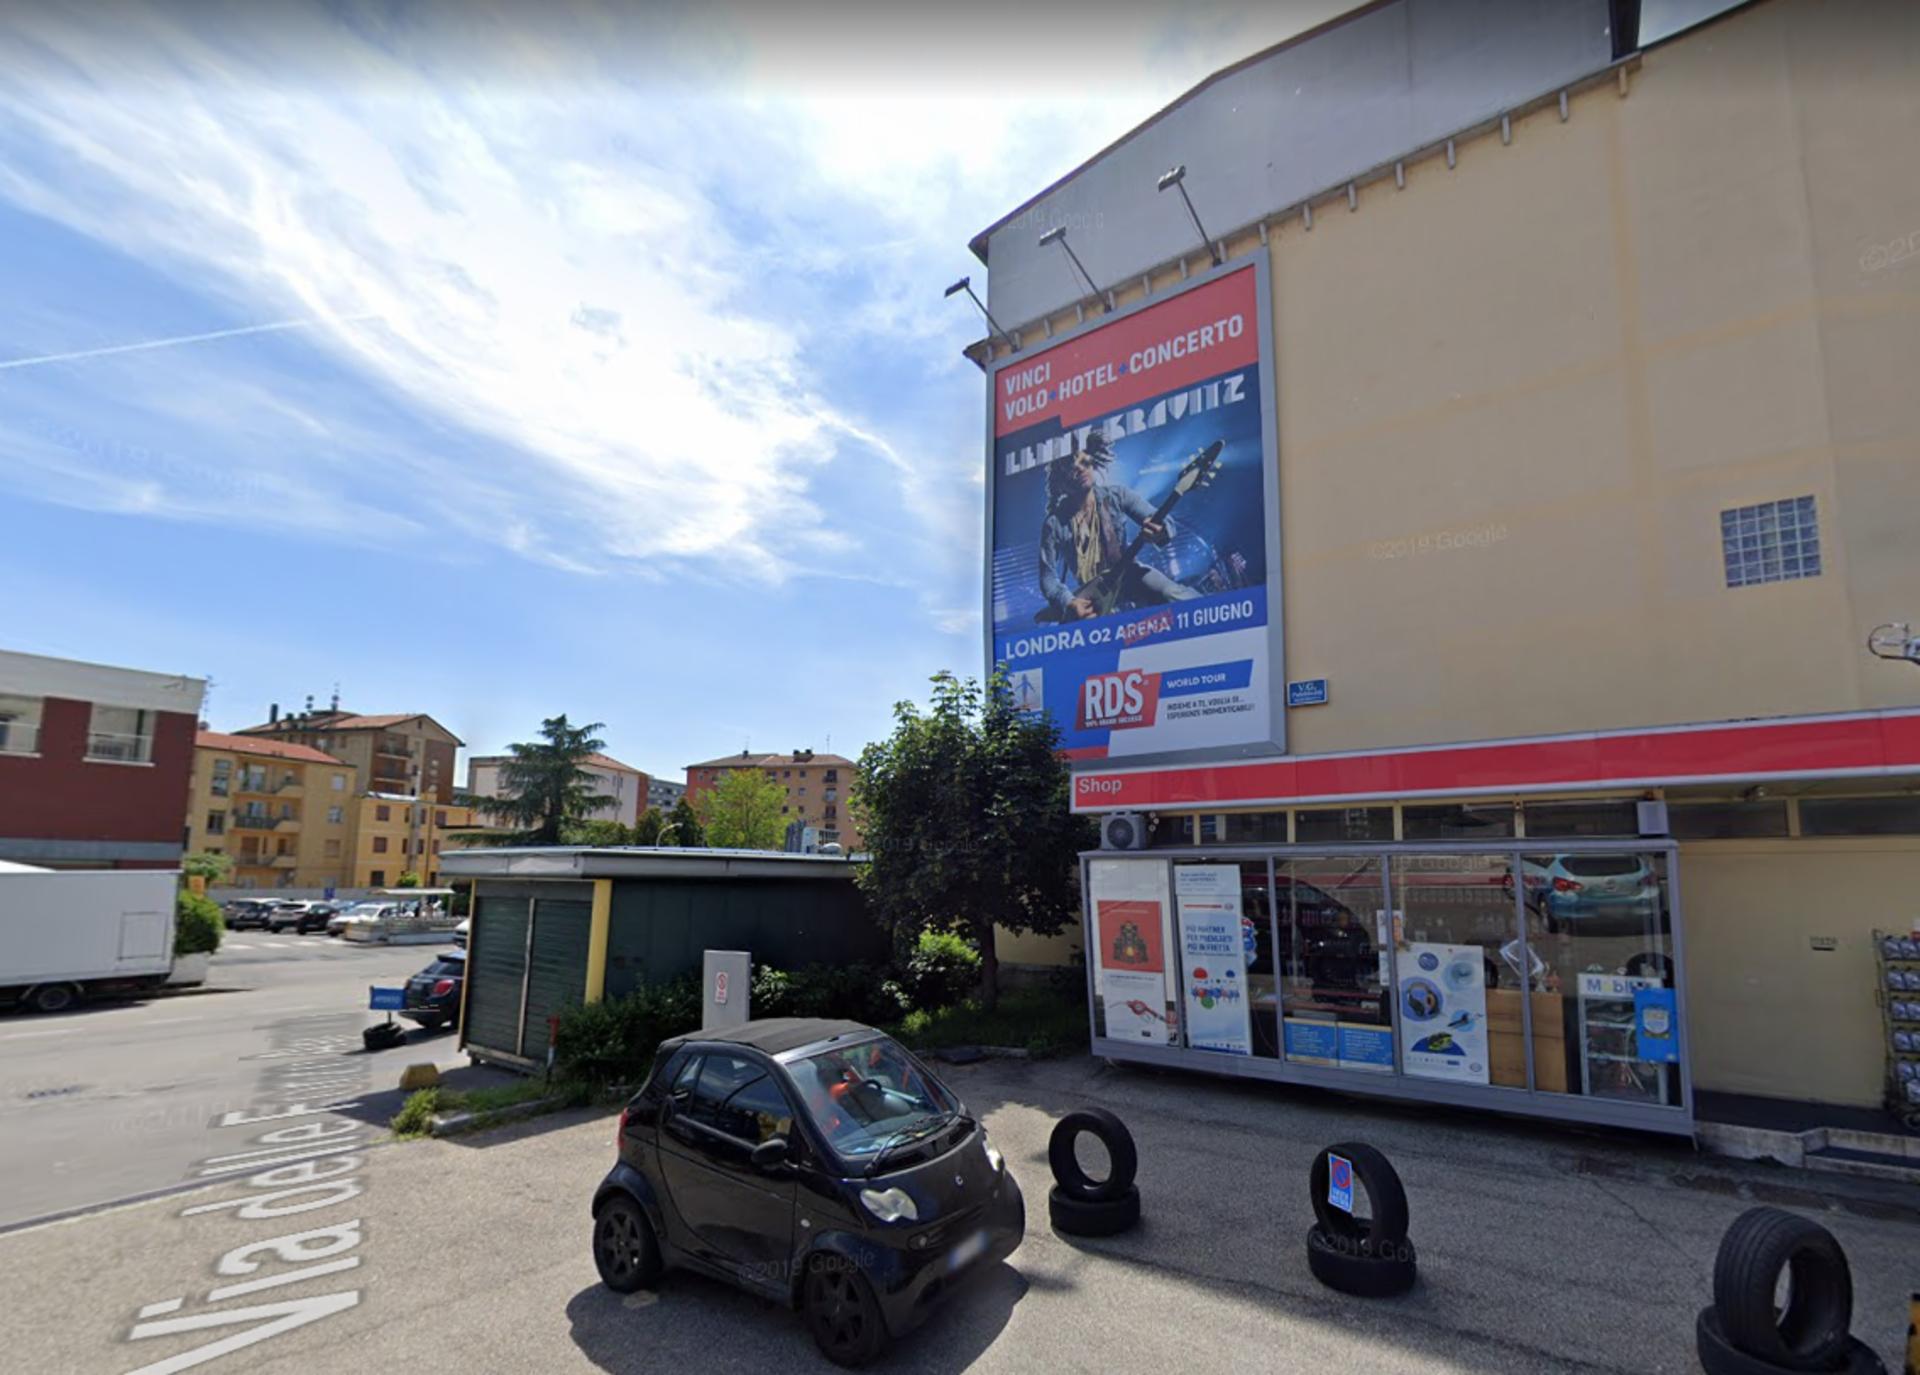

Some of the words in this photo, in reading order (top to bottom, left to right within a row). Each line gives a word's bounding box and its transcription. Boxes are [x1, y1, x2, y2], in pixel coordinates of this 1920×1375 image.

[1005, 388, 1047, 421] VOLO
[1059, 364, 1118, 401] HOTEL
[1129, 314, 1244, 375] CONCERTO
[1005, 362, 1050, 396] VINCI
[1006, 629, 1085, 661] LONDRA
[1116, 617, 1172, 640] ARENA
[1177, 612, 1190, 629] 11
[1194, 601, 1254, 627] GIUGNO
[1085, 673, 1143, 720] RDS
[1167, 676, 1200, 689] WORLD
[1202, 673, 1226, 684] TOUR
[1078, 777, 1123, 794] Shop
